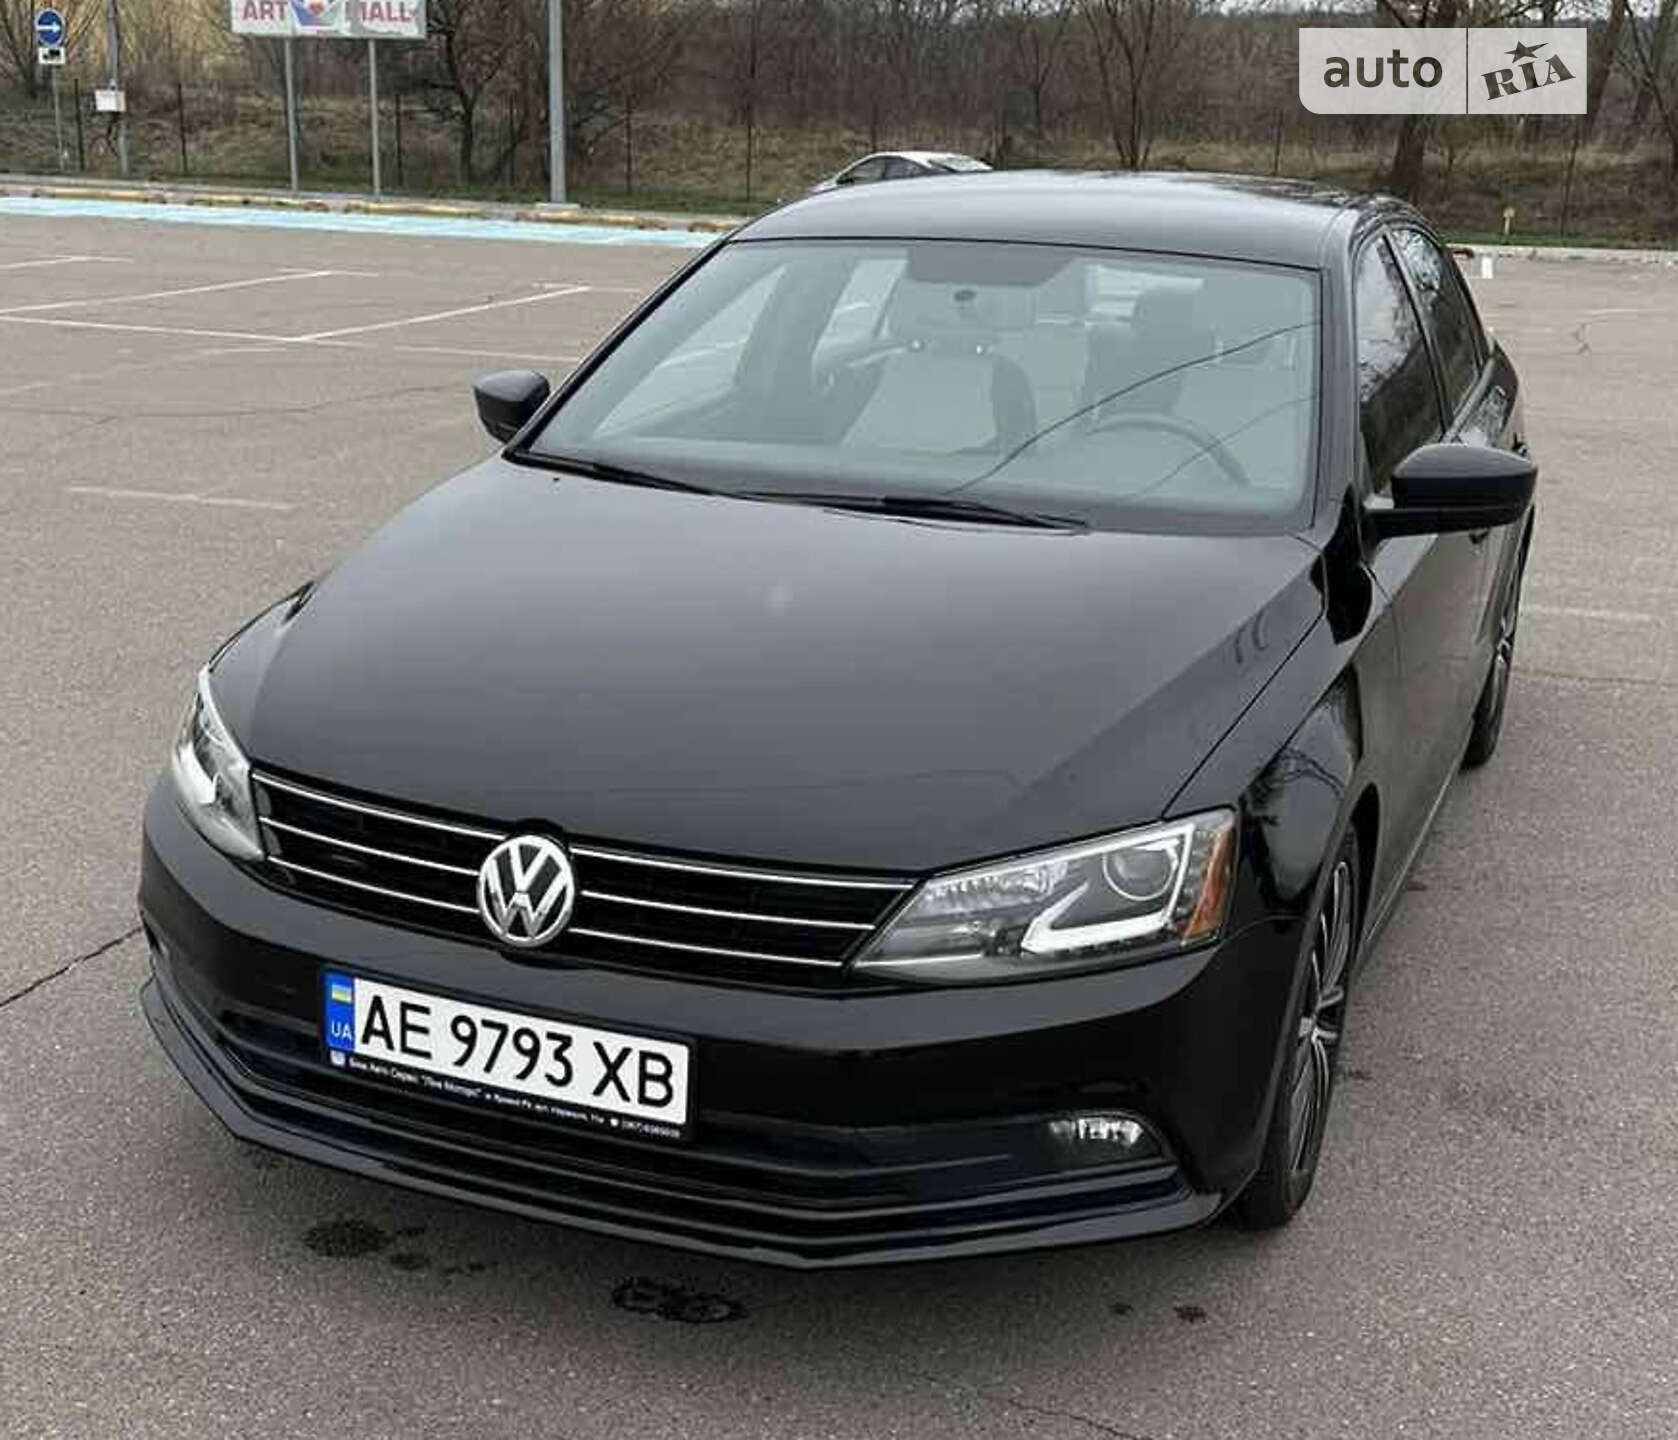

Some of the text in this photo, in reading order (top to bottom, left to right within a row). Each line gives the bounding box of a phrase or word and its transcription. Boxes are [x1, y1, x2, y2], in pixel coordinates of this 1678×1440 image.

[243, 0, 289, 21] ART
[331, 1021, 352, 1041] UA
[361, 995, 432, 1059] AE
[450, 1015, 573, 1088] 9793
[592, 1041, 673, 1108] XB
